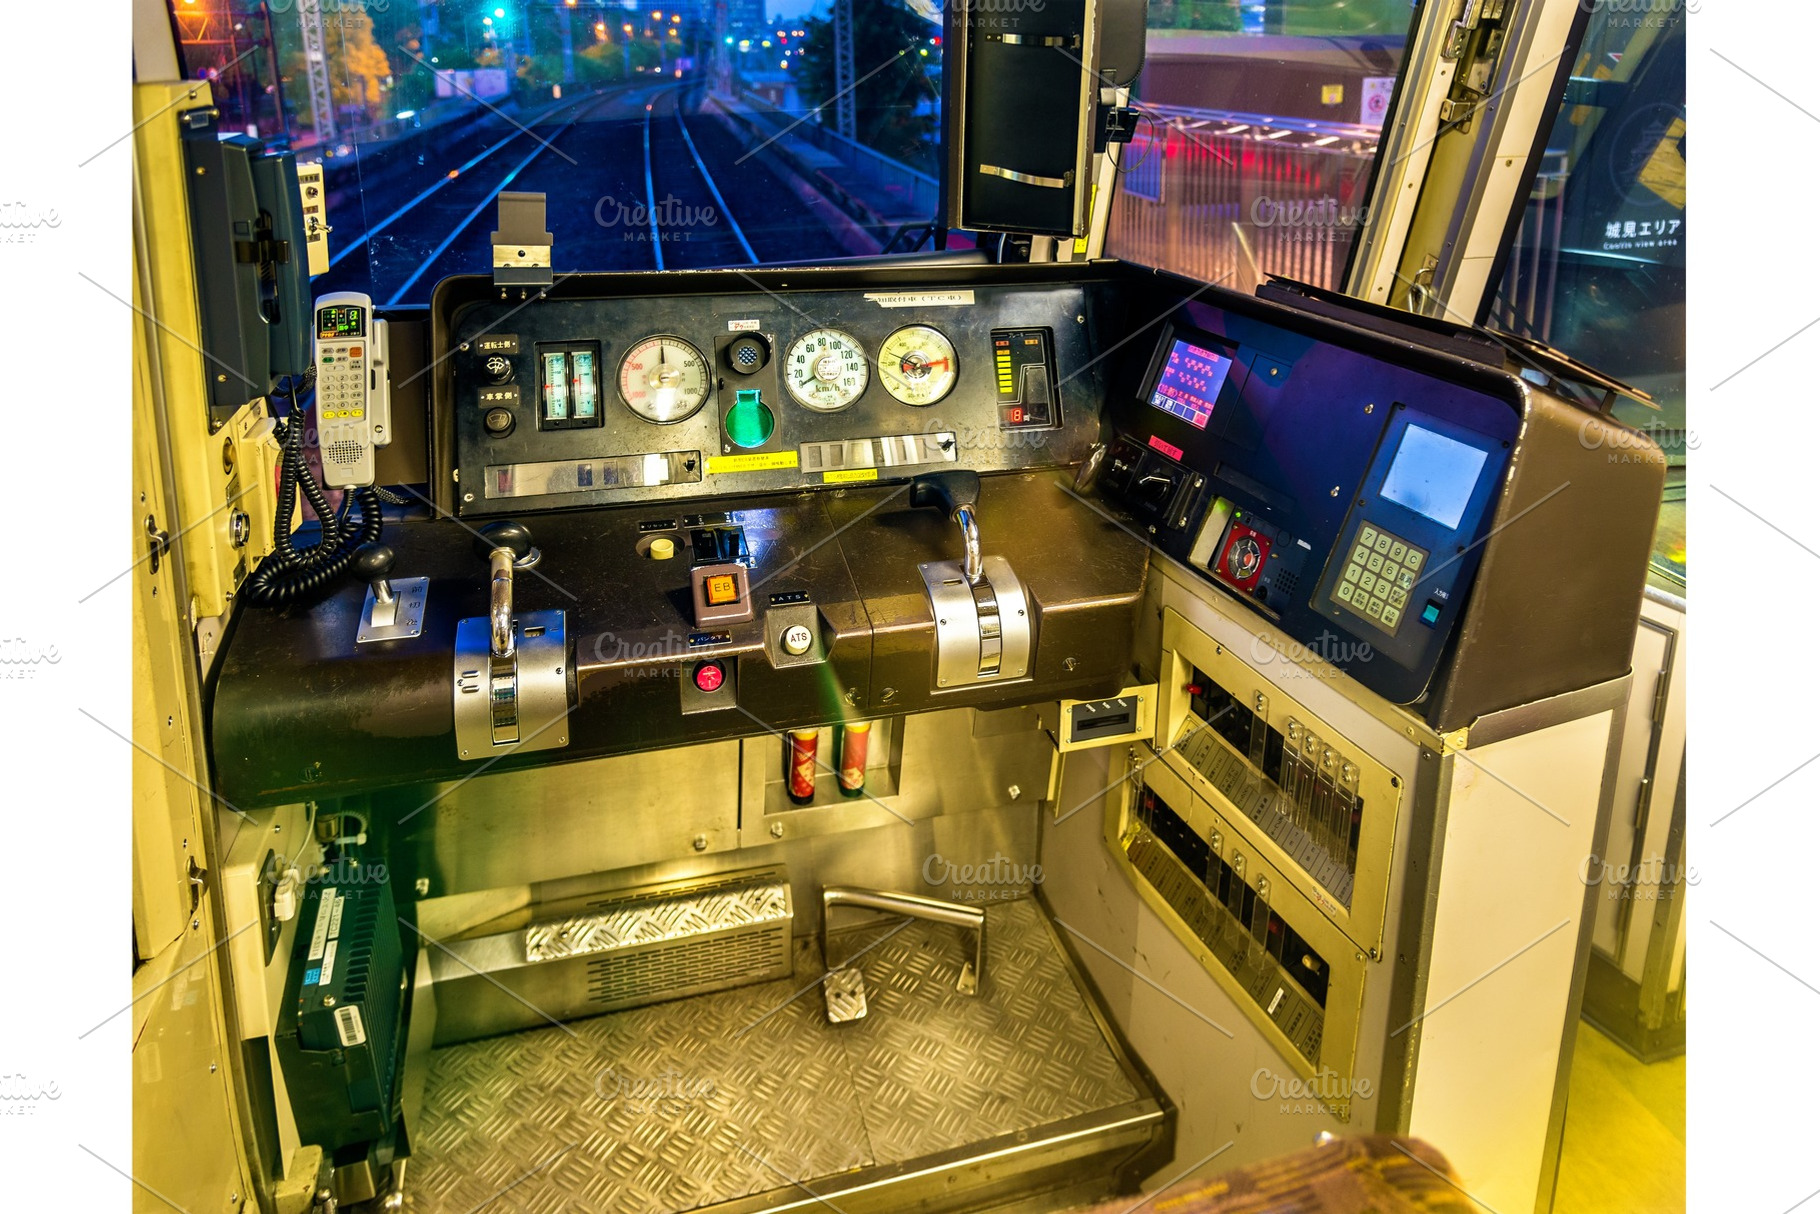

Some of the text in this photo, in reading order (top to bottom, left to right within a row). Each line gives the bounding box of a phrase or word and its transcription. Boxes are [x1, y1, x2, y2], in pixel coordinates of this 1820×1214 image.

[1605, 220, 1681, 238] 城見エリア
[818, 338, 826, 346] 80
[829, 341, 841, 350] 100
[806, 344, 814, 352] 60
[796, 355, 805, 363] 40
[841, 350, 853, 359] 120
[846, 363, 858, 371] 140
[794, 370, 803, 378] 20
[816, 384, 840, 392] km/h
[1365, 532, 1417, 564] 7 8 9 C
[1358, 551, 1393, 574] 4 5 6
[1351, 569, 1385, 593] 1 2 3
[714, 582, 731, 592] EB
[1342, 587, 1349, 595] 0
[791, 633, 808, 642] ATS
